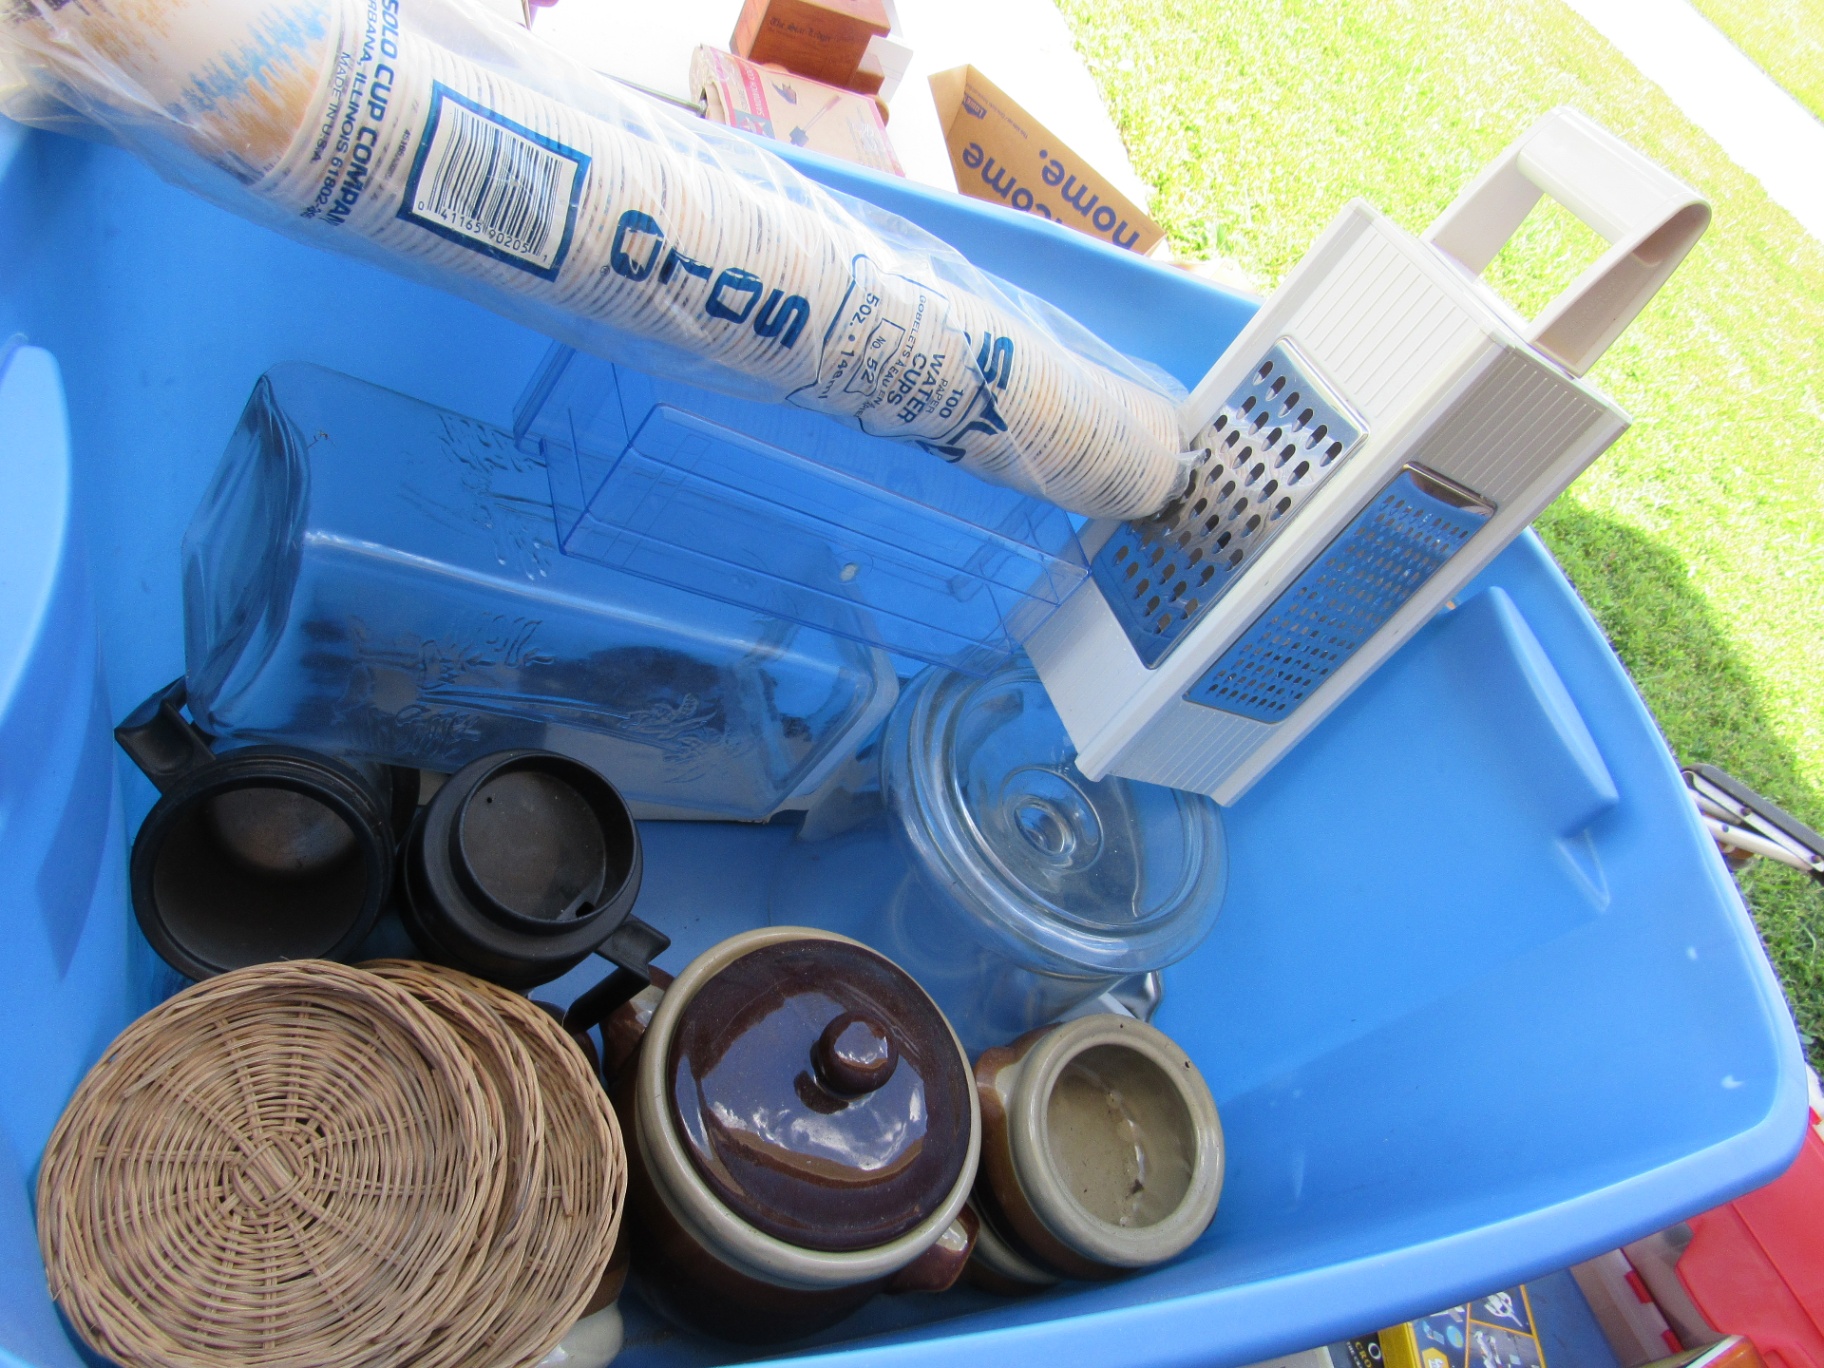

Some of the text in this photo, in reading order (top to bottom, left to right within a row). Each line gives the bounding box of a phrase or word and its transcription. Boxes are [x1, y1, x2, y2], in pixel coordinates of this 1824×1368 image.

[331, 52, 352, 97] MADE
[319, 0, 399, 226] SOLO CUP COMPAN
[326, 103, 339, 120] IN
[336, 72, 368, 153] ILLINOIS
[417, 200, 424, 211] 0
[441, 207, 481, 234] 41165
[488, 229, 529, 254] 90205
[611, 209, 810, 350] SOLO
[902, 294, 927, 358] GOBELETS
[861, 335, 886, 385] NO. 52
[882, 366, 899, 388] EAU
[887, 353, 927, 406] CUPS
[897, 353, 946, 423] WATER
[925, 378, 949, 413] PAPER
[939, 388, 964, 419] 100
